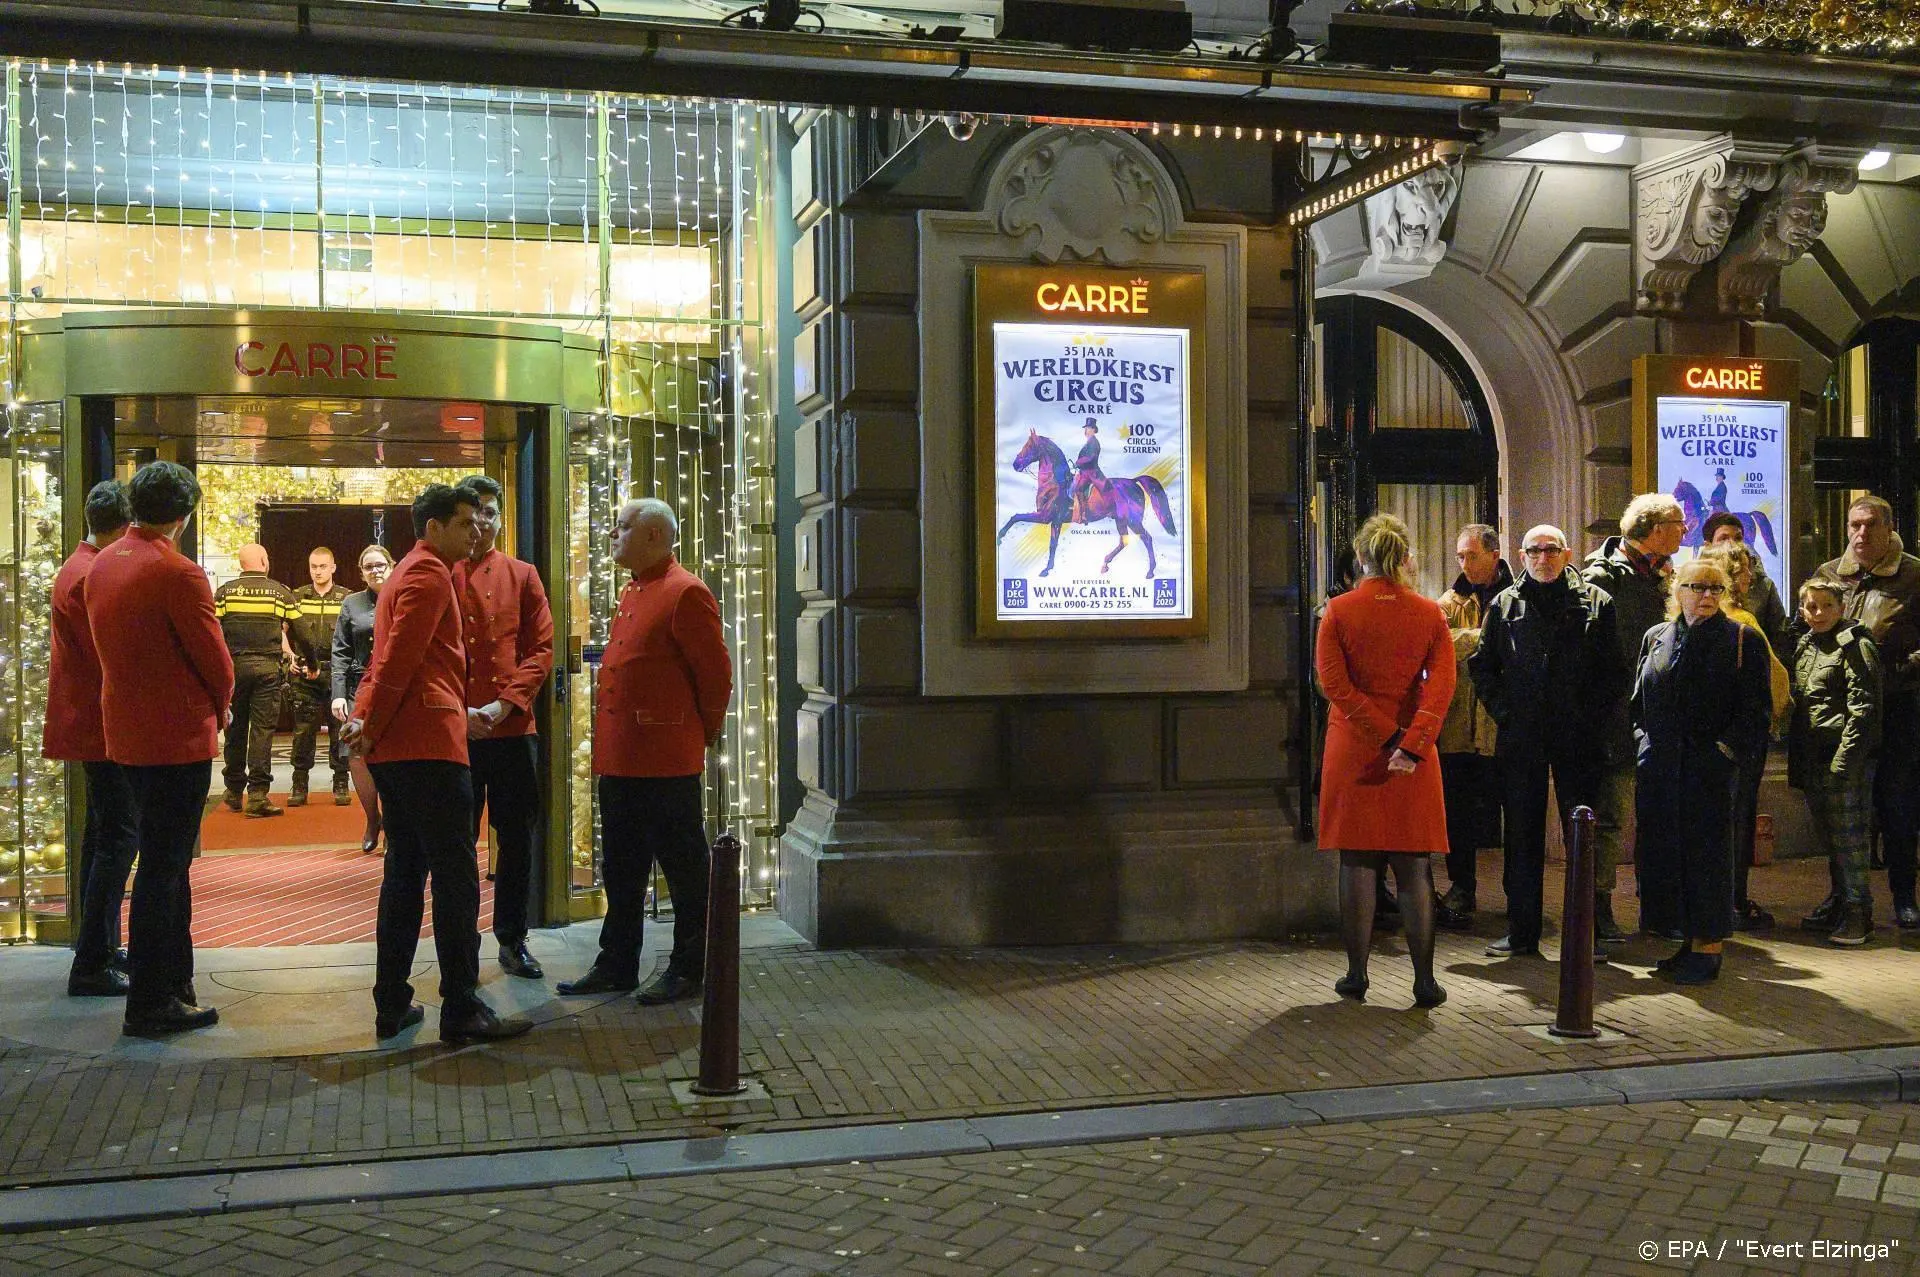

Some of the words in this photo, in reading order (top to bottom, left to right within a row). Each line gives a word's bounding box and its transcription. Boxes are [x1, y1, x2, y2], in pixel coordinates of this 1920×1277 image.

[1064, 346, 1079, 356] 35
[1082, 347, 1115, 358] JAAR
[1002, 357, 1175, 385] WERELDKERST
[1033, 379, 1145, 405] CIRCUS
[1701, 414, 1712, 423] 35
[1714, 414, 1737, 424] JAAR
[1128, 423, 1155, 436] 100
[1661, 423, 1778, 443] WERELDKERST
[1127, 438, 1157, 446] CIRCUS
[1123, 446, 1161, 454] STERREN!
[1681, 439, 1757, 459] CIRCUS
[1745, 472, 1763, 481] 100
[1010, 579, 1022, 589] 19
[1161, 579, 1169, 589] 5
[1006, 589, 1025, 598] DEC
[1033, 586, 1149, 598] WWW.CARRE.NL
[1156, 589, 1173, 598] JAN
[1007, 598, 1026, 607] 2019
[1064, 600, 1100, 609] 0900-25
[1103, 600, 1114, 609] 25
[1116, 600, 1132, 609] 255
[1155, 598, 1174, 606] 2020
